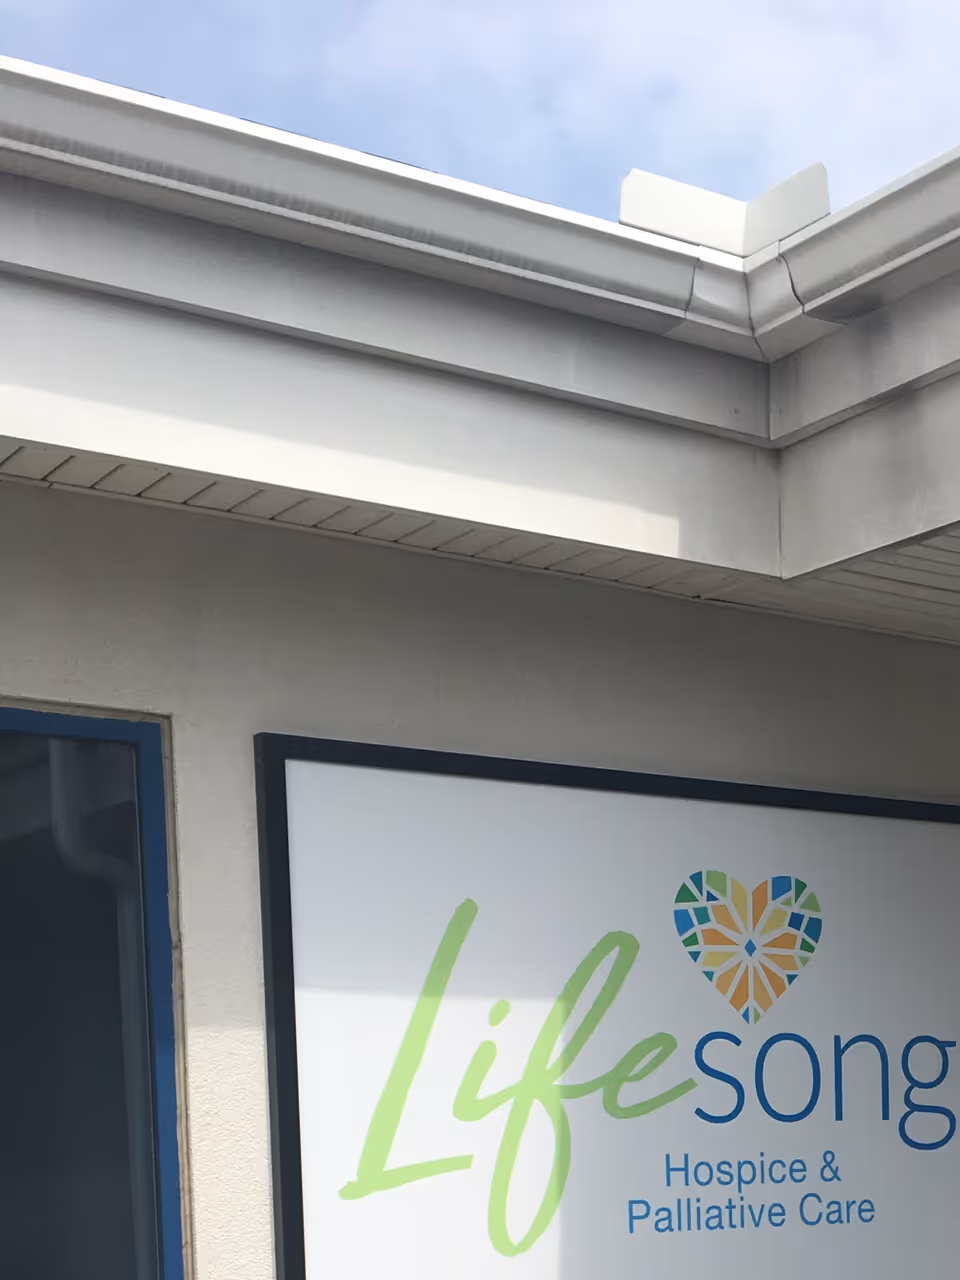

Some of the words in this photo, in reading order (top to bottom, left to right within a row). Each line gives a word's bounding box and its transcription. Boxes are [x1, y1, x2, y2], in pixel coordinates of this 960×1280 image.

[665, 1151, 808, 1193] Hospice
[819, 1150, 842, 1182] &
[627, 1195, 787, 1234] Palliative
[798, 1192, 876, 1226] Care
